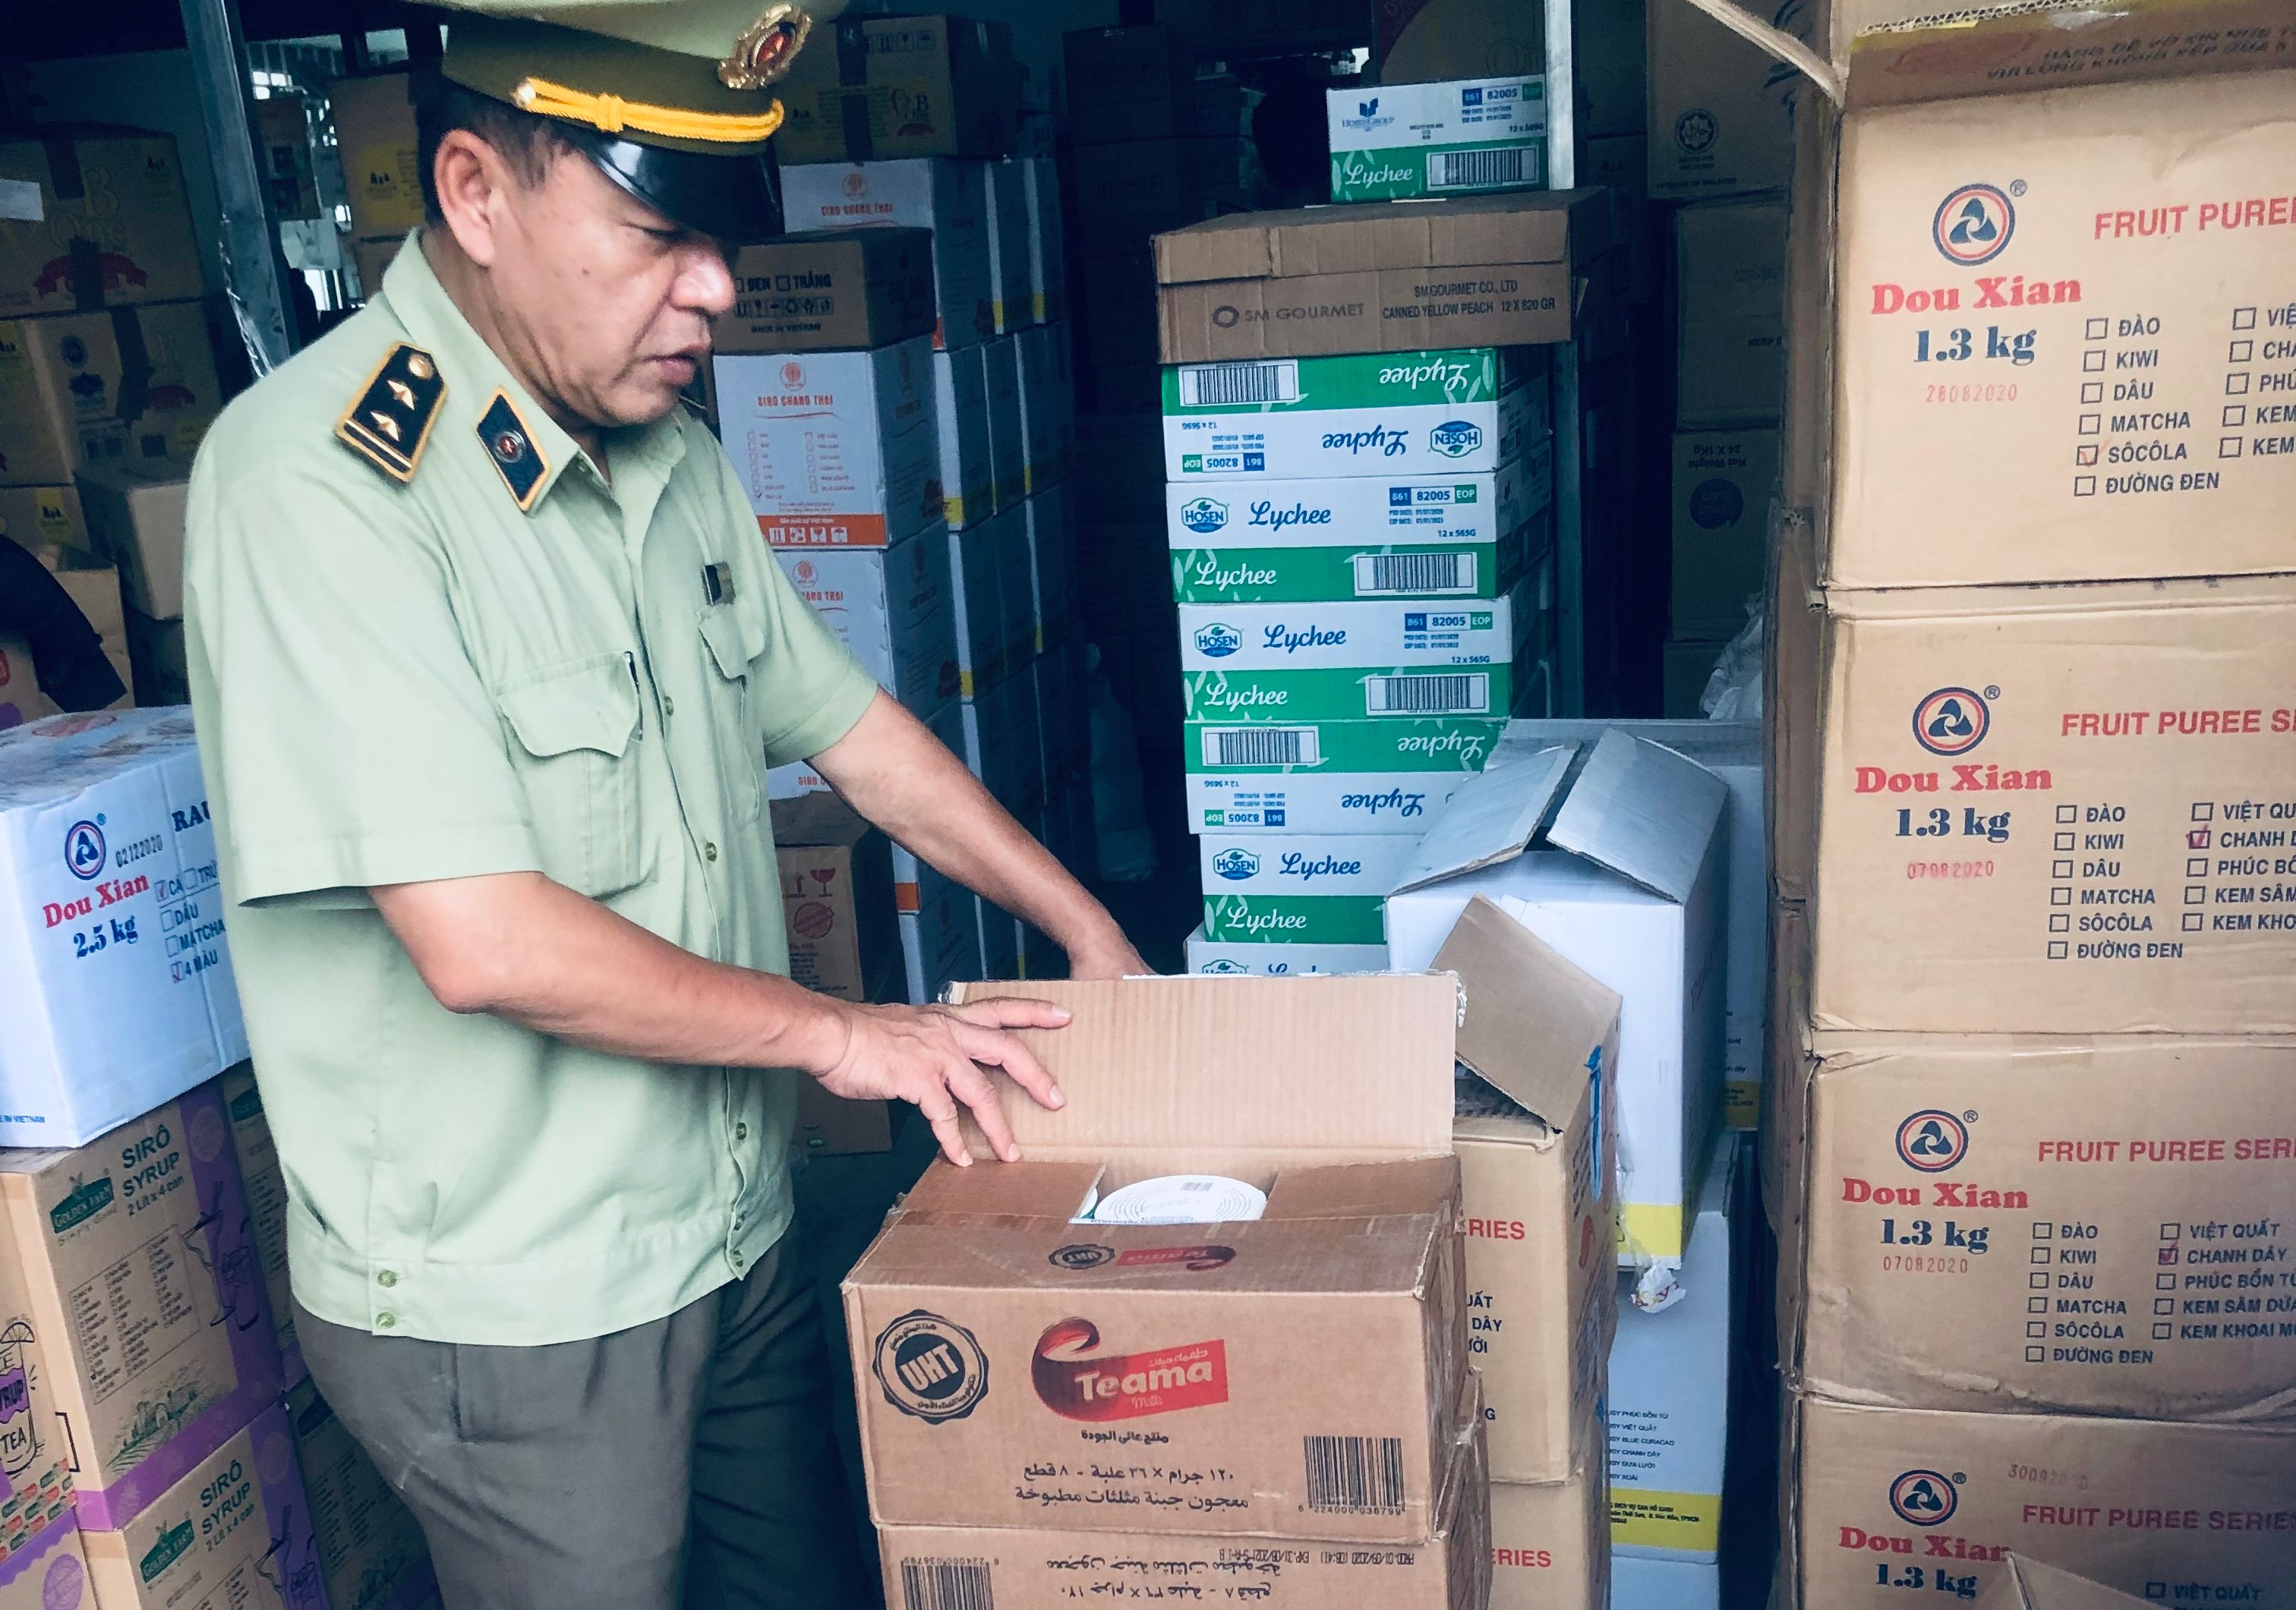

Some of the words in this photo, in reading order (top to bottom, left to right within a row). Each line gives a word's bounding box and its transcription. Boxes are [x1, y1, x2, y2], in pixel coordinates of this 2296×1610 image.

[1487, 88, 1519, 100] 82005
[1345, 165, 1413, 188] Lychee
[1871, 282, 1960, 316] Dou
[1973, 275, 2082, 310] Xian
[2093, 204, 2189, 241] FRUIT
[1430, 282, 1476, 297] GOURMET
[1244, 309, 1269, 322] SM
[1276, 302, 1365, 321] GOURMET
[1383, 305, 1420, 320] CANNED
[1422, 303, 1459, 317] YELLOW
[1461, 301, 1493, 315] PEACH
[2118, 313, 2161, 337] ĐÀO
[1913, 327, 1973, 363] 1.3
[1985, 326, 2036, 366] kg
[2116, 349, 2159, 370] KIWI
[1380, 357, 1470, 391] Lychee
[1925, 384, 2018, 404] 28082020
[2114, 380, 2154, 401] DÂU
[2111, 411, 2191, 433] MATCHA
[1322, 424, 1408, 457] Lychee
[1435, 430, 1478, 446] HOSEN
[2108, 440, 2187, 464] SÔCÔLA
[2253, 436, 2294, 456] KEM
[1184, 459, 1201, 468] EOP
[1206, 458, 1239, 468] 82005
[2106, 471, 2174, 493] ĐƯỜNG
[2180, 472, 2220, 490] ĐEN
[1392, 493, 1408, 501] 861
[1417, 491, 1450, 501] 82005
[1456, 490, 1475, 499] EOP
[1184, 509, 1224, 524] HOSEN
[1248, 501, 1332, 531] Lychee
[1455, 529, 1476, 537] 565G
[1194, 561, 1277, 592] Lychee
[1407, 618, 1424, 626] 861
[1432, 616, 1466, 627] 82005
[1471, 616, 1491, 625] EOP
[1198, 635, 1238, 649] HOSEN
[1263, 624, 1347, 654] Lychee
[1469, 655, 1490, 663] 565G
[1204, 682, 1288, 712] Lychee
[1397, 729, 1486, 760] Lychee
[1854, 765, 1940, 794] Dou
[1951, 764, 2053, 792] Xian
[2061, 711, 2150, 737] FRUIT
[2157, 709, 2263, 735] PUREE
[1341, 788, 1425, 818] Lychee
[2086, 802, 2126, 824] ĐÀO
[2223, 800, 2263, 824] VIỆT
[1228, 814, 1260, 823] 82005
[1895, 808, 1951, 837] 1.3
[1962, 807, 2011, 843] kg
[115, 833, 163, 868] 02122020
[2085, 833, 2124, 850] KIWI
[2220, 830, 2286, 849] CHANH
[1216, 858, 1257, 872] HOSEN
[1279, 852, 1361, 881] Lychee
[1906, 860, 1995, 880] 07082020
[2083, 858, 2121, 878] DÂU
[2217, 855, 2269, 877] PHÚC
[43, 896, 93, 929] Dou
[96, 874, 149, 909] Xian
[2080, 888, 2156, 906] MATCHA
[2215, 887, 2255, 904] KEM
[1225, 906, 1307, 934] Lychee
[2078, 913, 2153, 932] SÔCÔLA
[2212, 914, 2253, 931] KEM
[73, 925, 108, 960] 2.5
[109, 914, 139, 945] kg
[179, 918, 226, 951] MATCHA
[2077, 940, 2142, 959] ĐƯỜNG
[2146, 942, 2184, 959] ĐEN
[122, 1124, 171, 1169] SIRÔ
[122, 1151, 180, 1198] SYRUP
[1840, 1177, 1922, 1208] Dou
[1932, 1182, 2029, 1209] Xian
[2037, 1140, 2121, 1163] FRUIT
[2129, 1139, 2225, 1162] PUREE
[1880, 1218, 1933, 1246] 1.3
[1944, 1220, 1991, 1256] kg
[2061, 1220, 2099, 1240] ĐÀO
[2190, 1220, 2229, 1243] VIỆT
[2231, 1218, 2281, 1239] QUẤT
[1883, 1255, 1969, 1274] 07082020
[2059, 1248, 2097, 1265] KIWI
[2187, 1247, 2247, 1265] CHANH
[2251, 1245, 2287, 1264] DÂY
[2058, 1270, 2094, 1290] DÂU
[2184, 1270, 2233, 1290] PHÚC
[2056, 1299, 2127, 1315] MATCHA
[2182, 1299, 2219, 1315] KEM
[2224, 1295, 2263, 1315] SÂM
[1471, 1315, 1503, 1332] DÂY
[2054, 1319, 2124, 1340] SÔCÔLA
[2180, 1324, 2217, 1340] KEM
[2223, 1322, 2274, 1339] KHOAI
[2052, 1344, 2113, 1364] ĐƯỜNG
[2119, 1347, 2153, 1364] ĐEN
[900, 1343, 959, 1391] UHT
[1074, 1360, 1214, 1402] Teama
[1, 1427, 27, 1454] TEA
[1081, 1429, 1117, 1444] الجودة
[1023, 1462, 1057, 1481] قطع
[1090, 1464, 1127, 1484] علبة
[1168, 1468, 1204, 1485] جرام
[200, 1459, 243, 1508] SIRÔ
[1014, 1486, 1082, 1508] مطبوخة
[1084, 1489, 1141, 1504] مثلثات
[1144, 1490, 1184, 1511] جبنة
[1187, 1495, 1249, 1513] معجون
[202, 1482, 251, 1535] SYRUP
[1837, 1526, 1913, 1554] Dou
[2022, 1503, 2101, 1527] FRUIT
[2108, 1507, 2200, 1530] PUREE
[1046, 1554, 1105, 1571] معجون
[1109, 1555, 1149, 1575] جبنة
[1152, 1561, 1210, 1576] مثلثات
[1090, 1582, 1125, 1599] جرام
[1167, 1582, 1203, 1600] علبة
[1237, 1582, 1273, 1601] قطع
[1876, 1563, 1924, 1590] 1.3
[1934, 1567, 1979, 1600] kg
